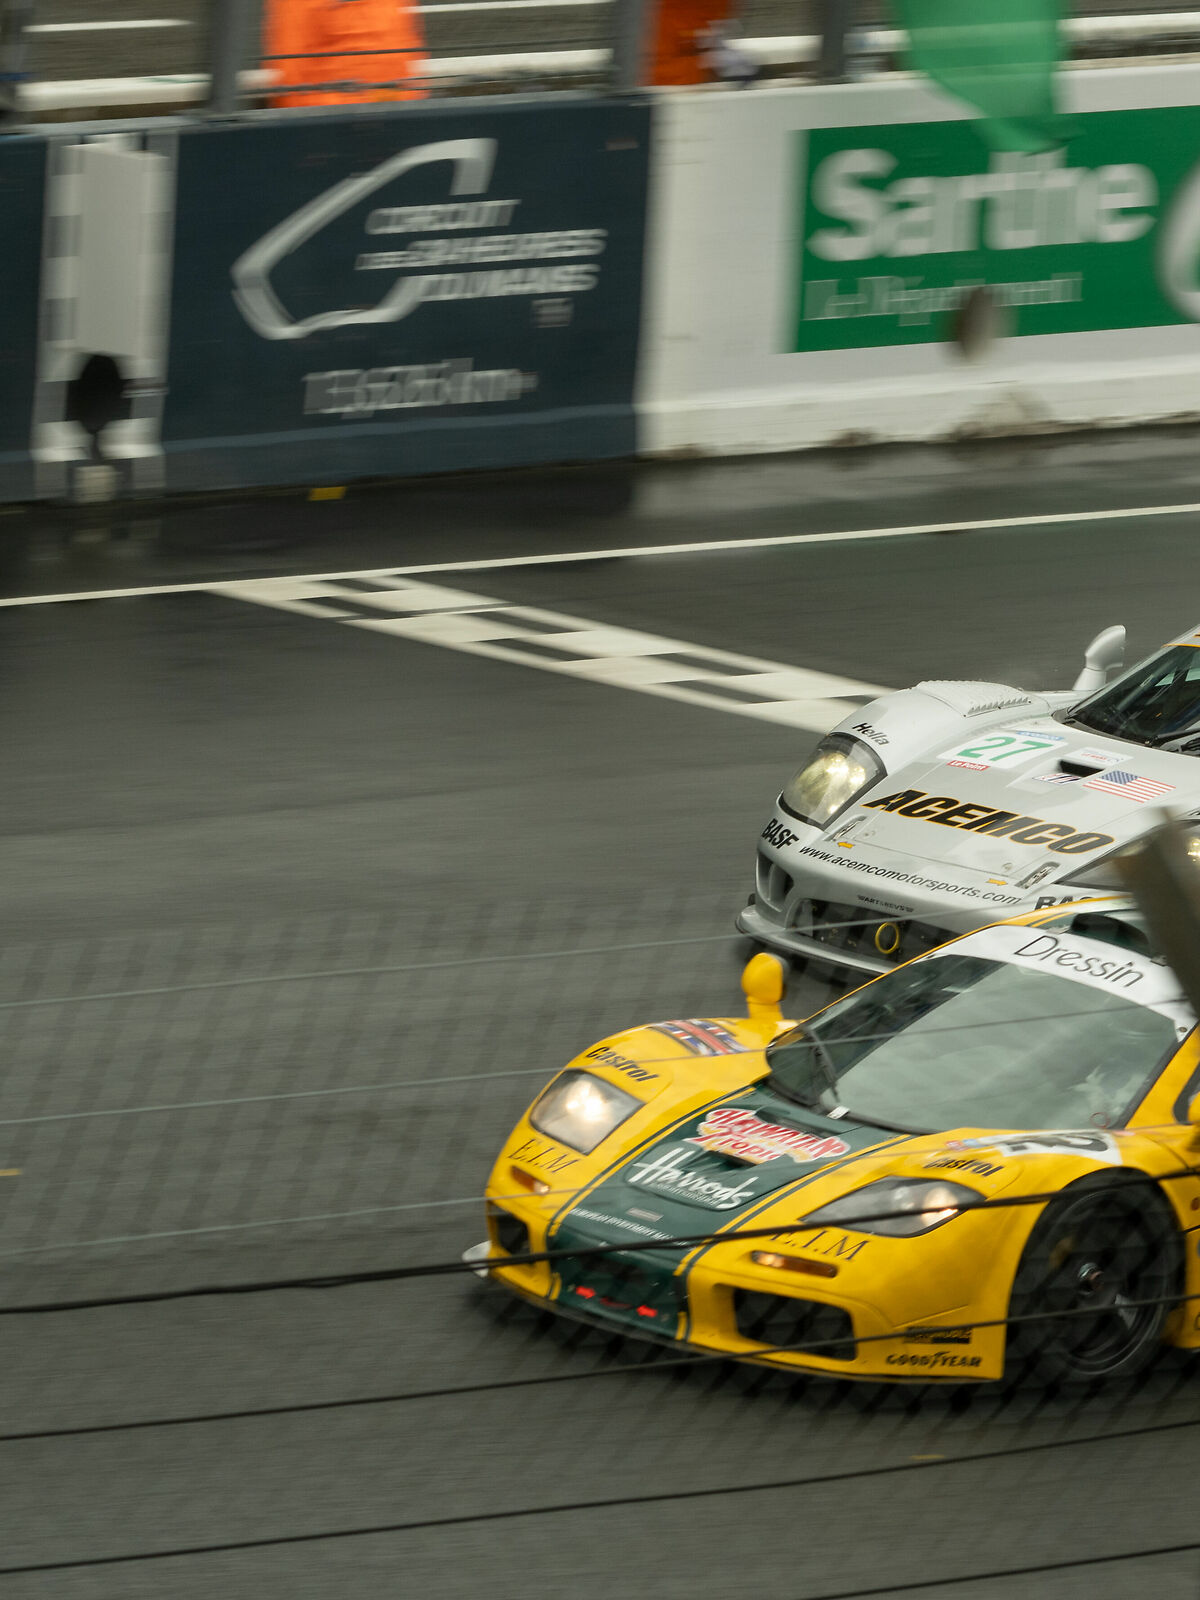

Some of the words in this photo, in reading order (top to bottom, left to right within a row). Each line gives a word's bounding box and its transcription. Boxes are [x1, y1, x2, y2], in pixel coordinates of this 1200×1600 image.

[806, 147, 1158, 262] Sarthe
[852, 722, 890, 746] Hella
[956, 736, 1053, 762] 27
[761, 818, 800, 850] BASF
[860, 789, 1116, 855] ACEMCO
[799, 846, 1021, 905] www.acemcomotorsports.com
[1013, 935, 1144, 987] Dressin
[586, 1046, 660, 1082] Castrol
[508, 1139, 582, 1173] E.I.M
[923, 1158, 1004, 1177] Castrol
[632, 1147, 759, 1209] Harrods
[886, 1351, 982, 1368] GOODYEAR
